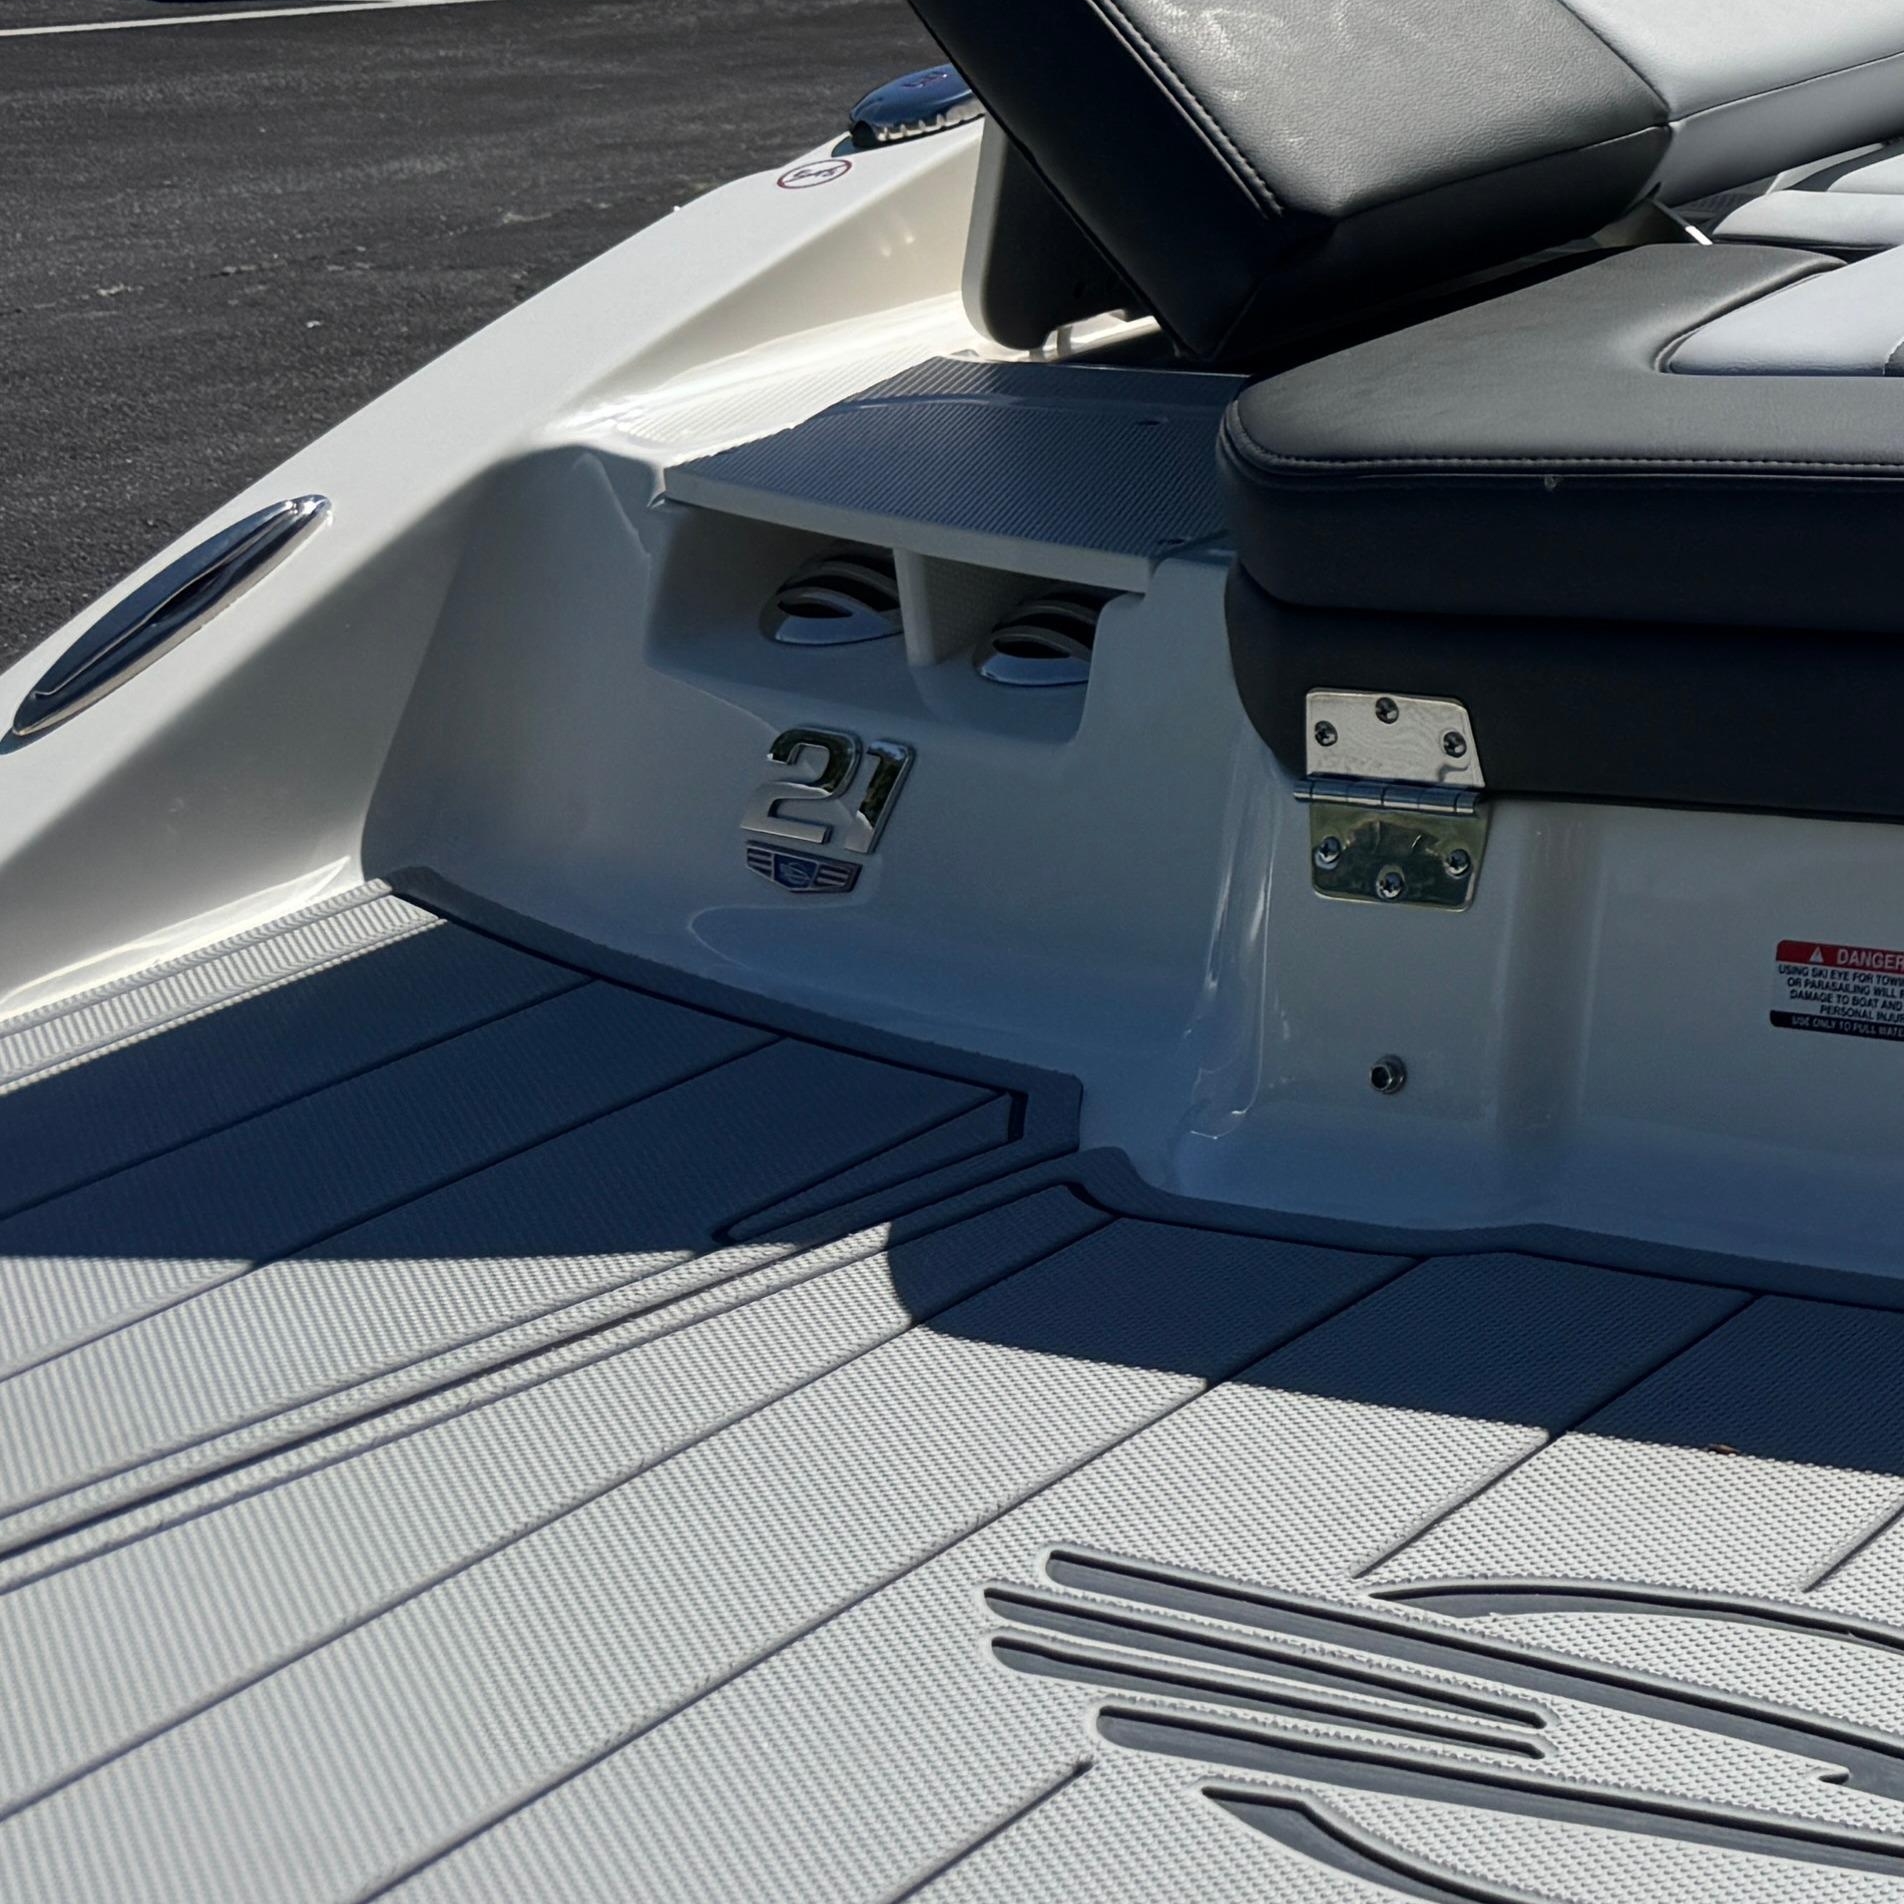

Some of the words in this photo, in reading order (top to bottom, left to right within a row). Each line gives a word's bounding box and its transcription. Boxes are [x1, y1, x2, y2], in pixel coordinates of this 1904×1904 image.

[739, 725, 915, 855] 21
[1778, 964, 1808, 978] USING
[1811, 968, 1829, 980] SKI
[1830, 970, 1850, 982] EYE
[1852, 972, 1873, 984] FOR
[1787, 977, 1802, 988] OR
[1804, 979, 1870, 996] PARASAILING
[1873, 986, 1897, 998] WILL
[1790, 989, 1833, 1004] DAMAGE
[1837, 994, 1849, 1006] TO
[1851, 996, 1878, 1009] BOAT
[1881, 999, 1901, 1011] AND
